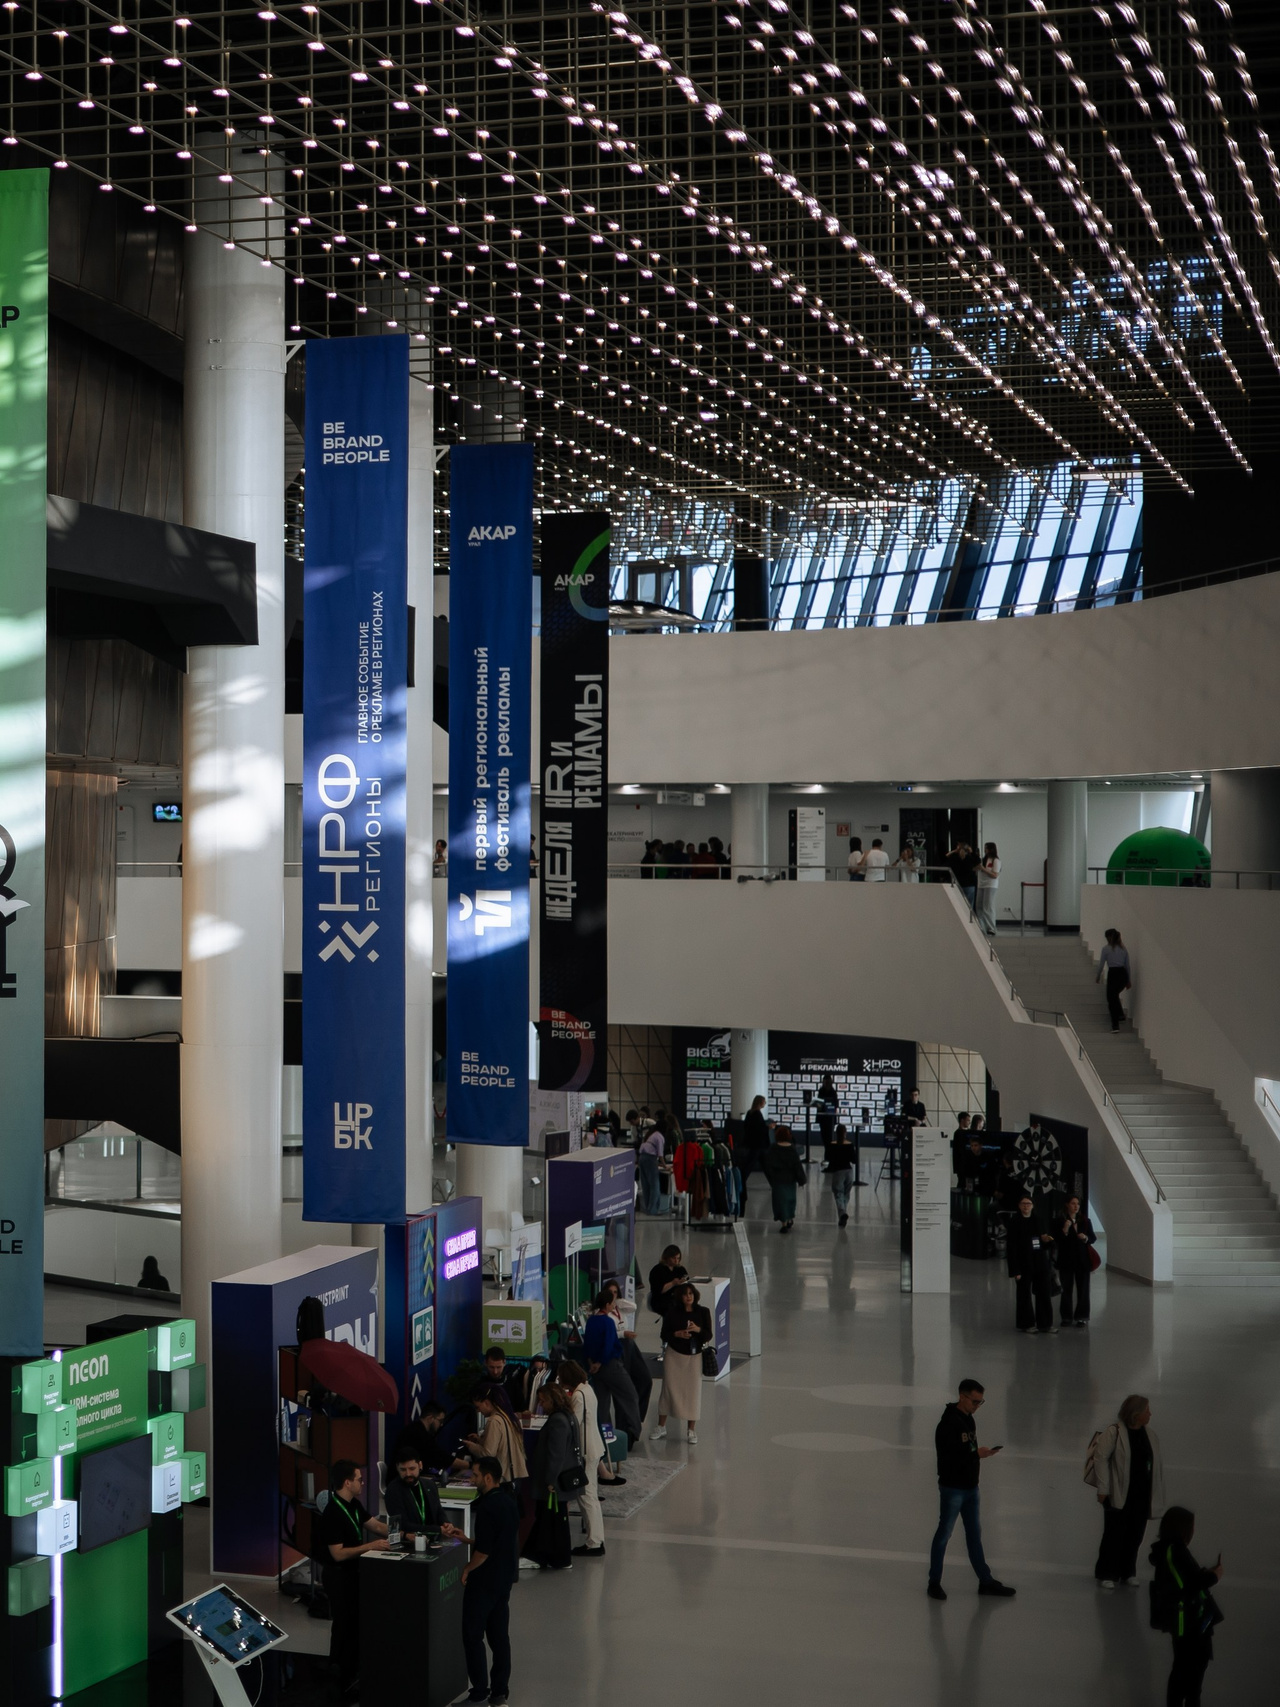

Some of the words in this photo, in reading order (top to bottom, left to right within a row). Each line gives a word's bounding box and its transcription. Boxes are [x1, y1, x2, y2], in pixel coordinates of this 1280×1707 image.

[323, 422, 345, 435] BE
[323, 435, 383, 450] BRAND
[323, 450, 390, 464] PEOPLE
[468, 525, 516, 540] АКАР
[554, 574, 595, 586] АКАР
[372, 591, 383, 660] РЕГИОНАХ
[357, 622, 370, 684] СОБЫТИЕ
[373, 661, 383, 670] В
[371, 671, 383, 732] РЕКЛАМЕ
[358, 686, 369, 743] ГЛАВНОЕ
[474, 647, 490, 788] региональный
[498, 667, 513, 757] рекламы
[372, 733, 382, 743] О
[574, 674, 602, 808] РЕКЛАМЫ
[545, 763, 572, 808] HR
[495, 767, 512, 872] фестиваль
[319, 754, 360, 912] НРФ
[473, 798, 490, 871] первый
[366, 777, 382, 911] РЕГИОНЫ
[545, 821, 577, 921] НЕДЕЛЯ
[551, 1011, 565, 1020] BE
[551, 1020, 591, 1030] BRAND
[551, 1030, 596, 1040] PEOPLE
[462, 1052, 478, 1062] BE
[687, 1047, 710, 1057] BIG
[462, 1064, 509, 1075] BRAND
[687, 1058, 720, 1068] FISH
[808, 1064, 848, 1072] РЕКЛАМЫ
[872, 1059, 901, 1069] НРФ
[462, 1076, 515, 1088] PEOPLE
[70, 1354, 109, 1386] neon
[76, 1411, 100, 1427] олного
[101, 1404, 122, 1420] цикла
